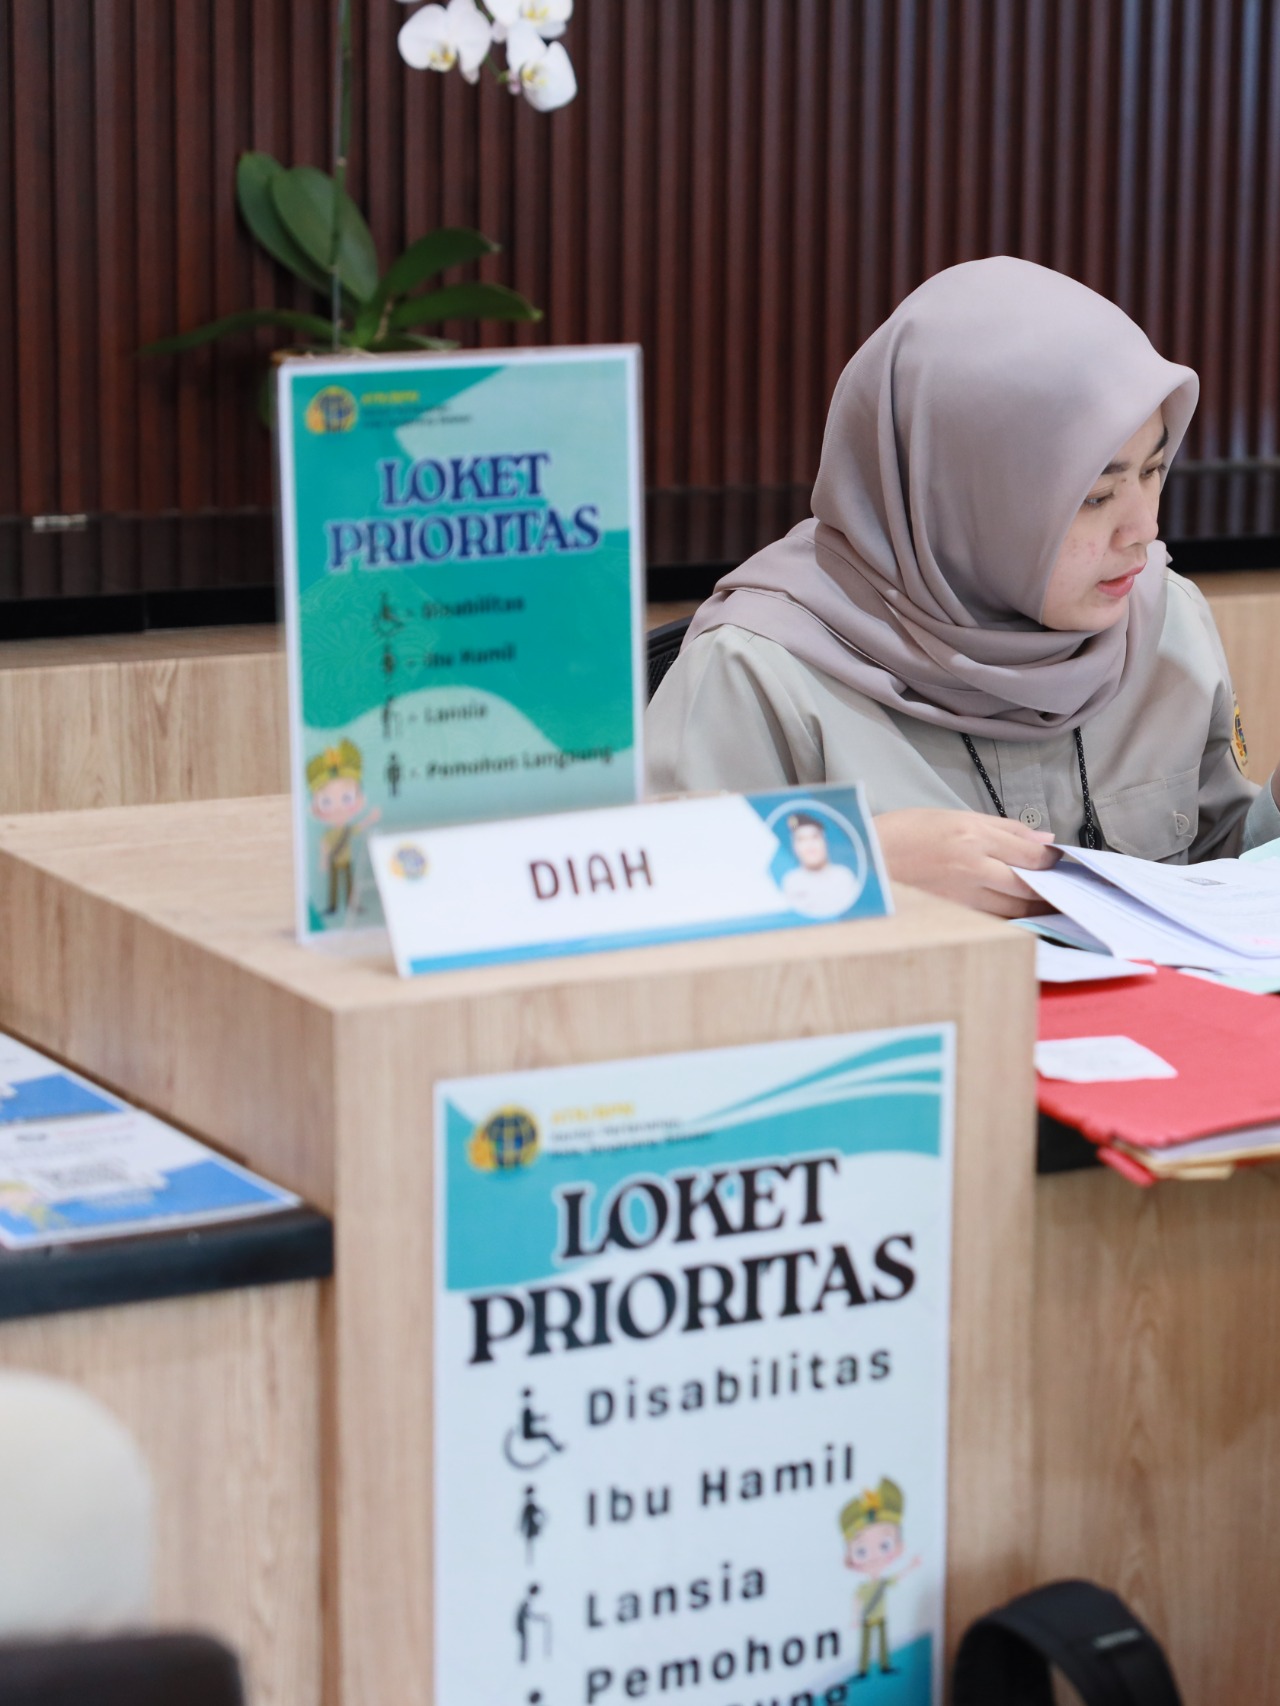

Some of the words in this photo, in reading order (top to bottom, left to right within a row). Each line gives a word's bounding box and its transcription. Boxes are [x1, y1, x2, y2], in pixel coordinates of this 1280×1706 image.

[380, 451, 550, 507] LOKET
[330, 506, 600, 572] PRIORITAS
[529, 849, 653, 900] DIAH
[557, 1157, 840, 1260] LOKET
[468, 1232, 918, 1365] PRIORITAS
[588, 1347, 894, 1427] Disabilitas
[587, 1483, 671, 1528] Ibu
[702, 1443, 857, 1507] Hamil
[587, 1562, 767, 1629] Lansia
[585, 1628, 842, 1705] Pemohon
